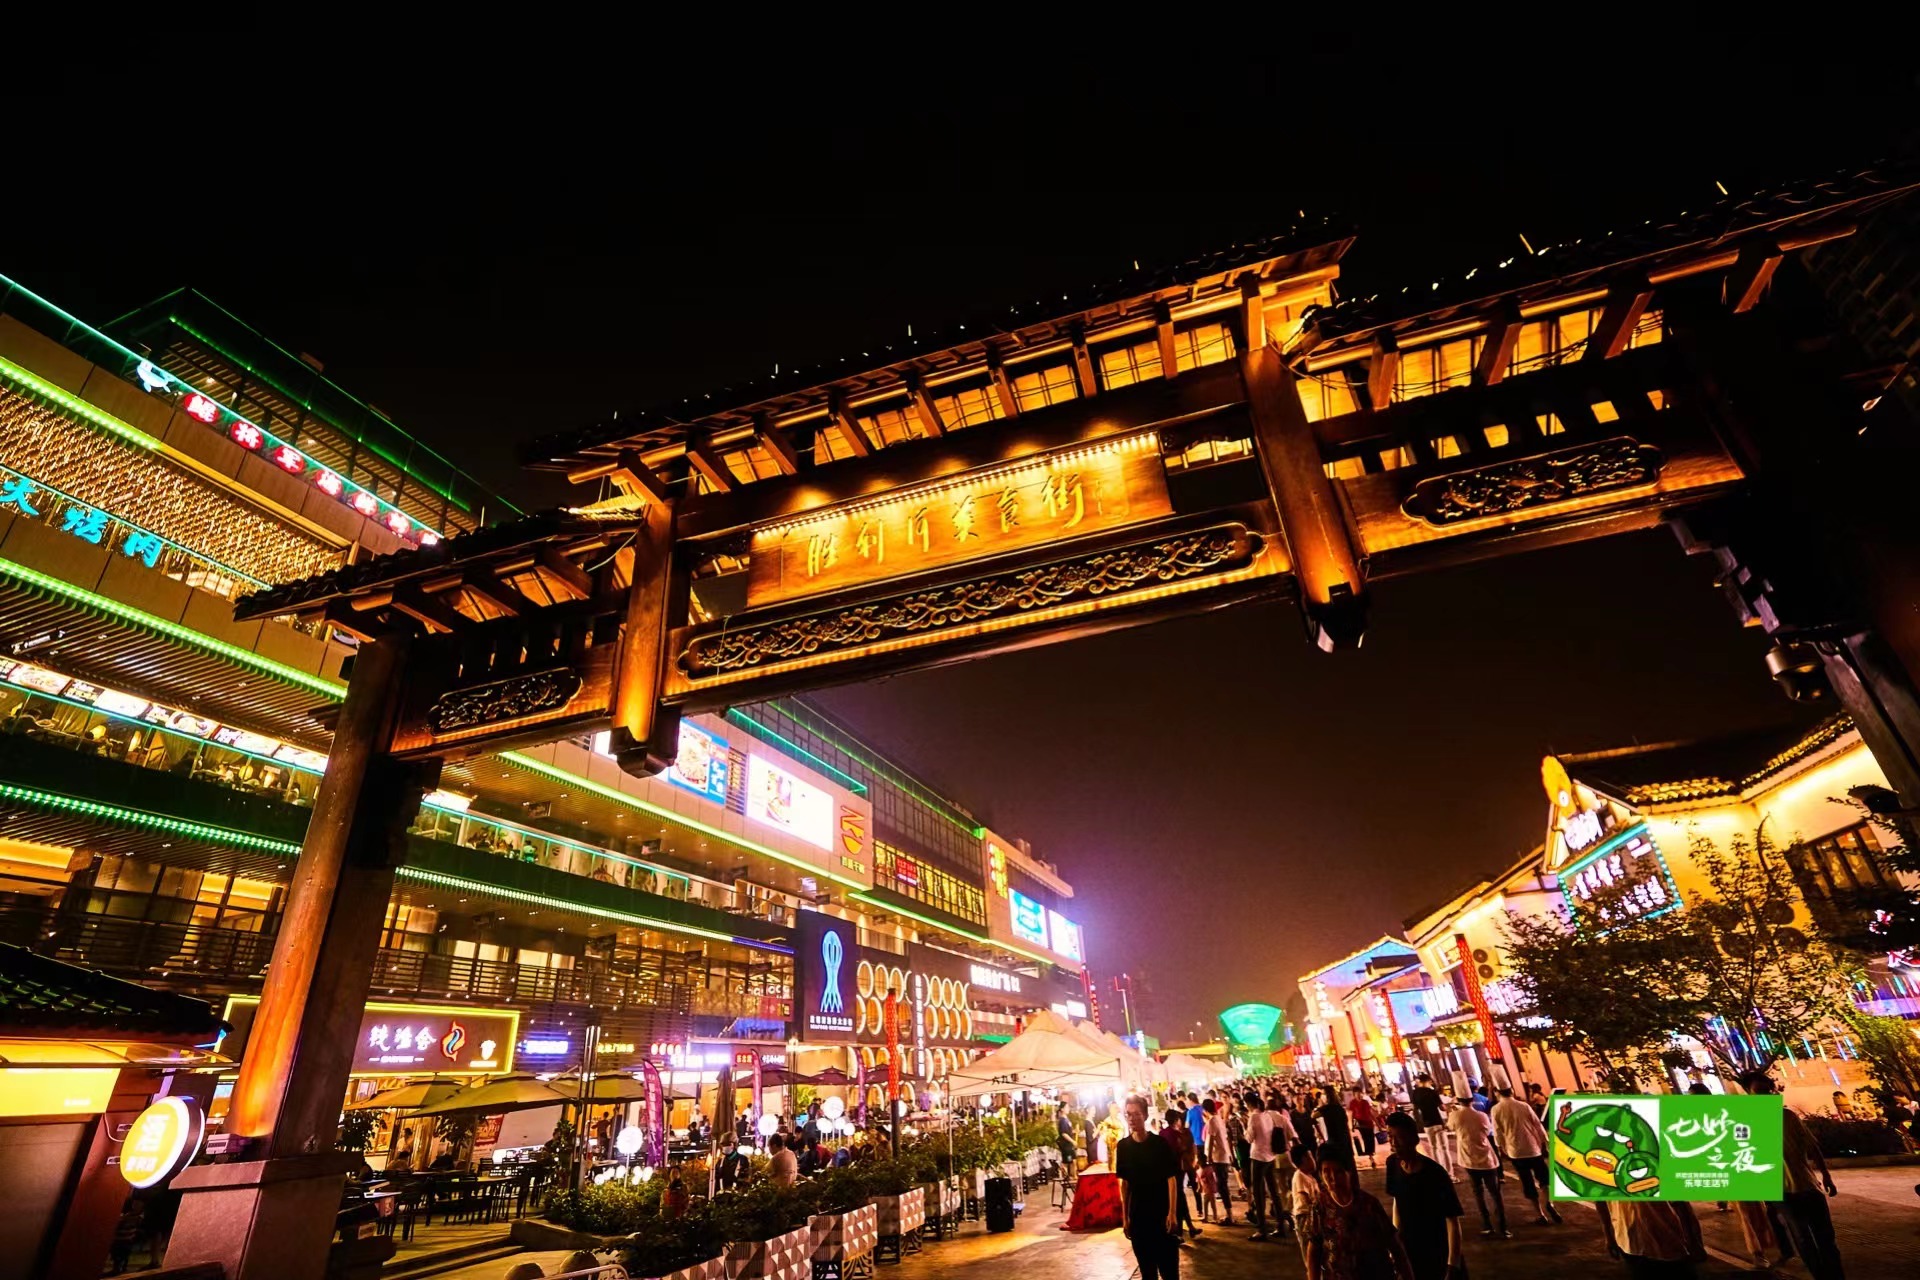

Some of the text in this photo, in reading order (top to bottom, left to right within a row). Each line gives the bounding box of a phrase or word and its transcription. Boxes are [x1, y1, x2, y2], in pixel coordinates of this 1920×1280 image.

[807, 472, 1084, 578] 胜利河美食街
